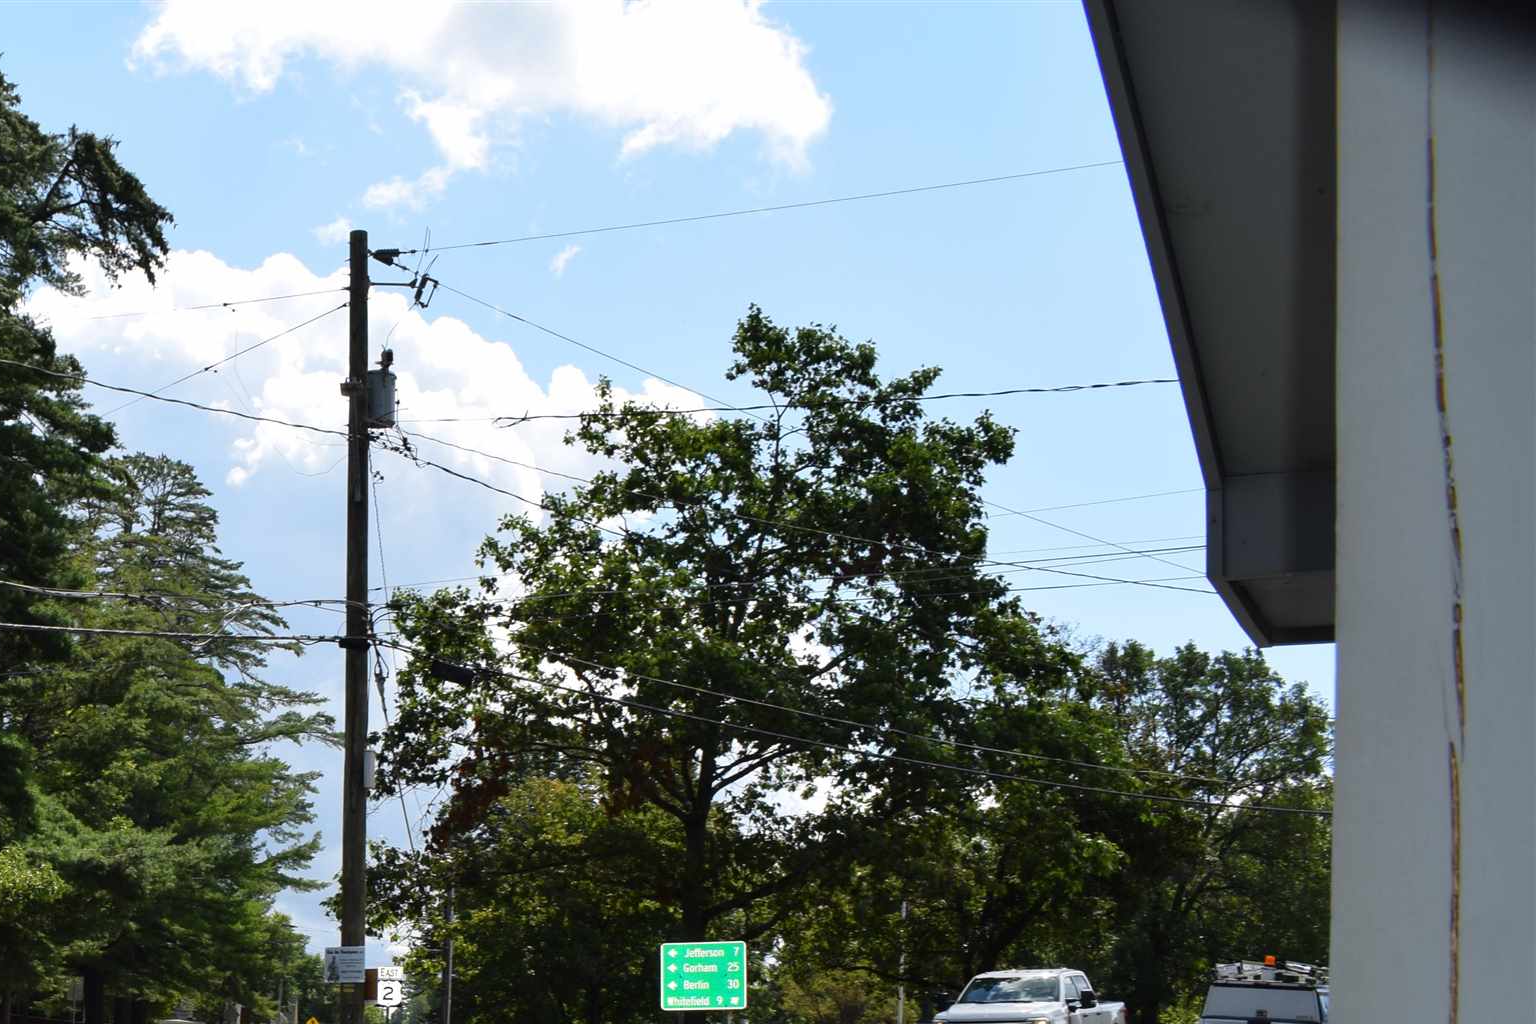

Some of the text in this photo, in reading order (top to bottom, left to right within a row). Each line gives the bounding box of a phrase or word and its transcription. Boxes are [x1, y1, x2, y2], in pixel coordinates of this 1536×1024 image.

[685, 948, 725, 958] Jefferson
[380, 968, 399, 977] EAST
[683, 963, 718, 973] Gorham
[382, 986, 394, 1001] 2
[716, 995, 724, 1005] 9
